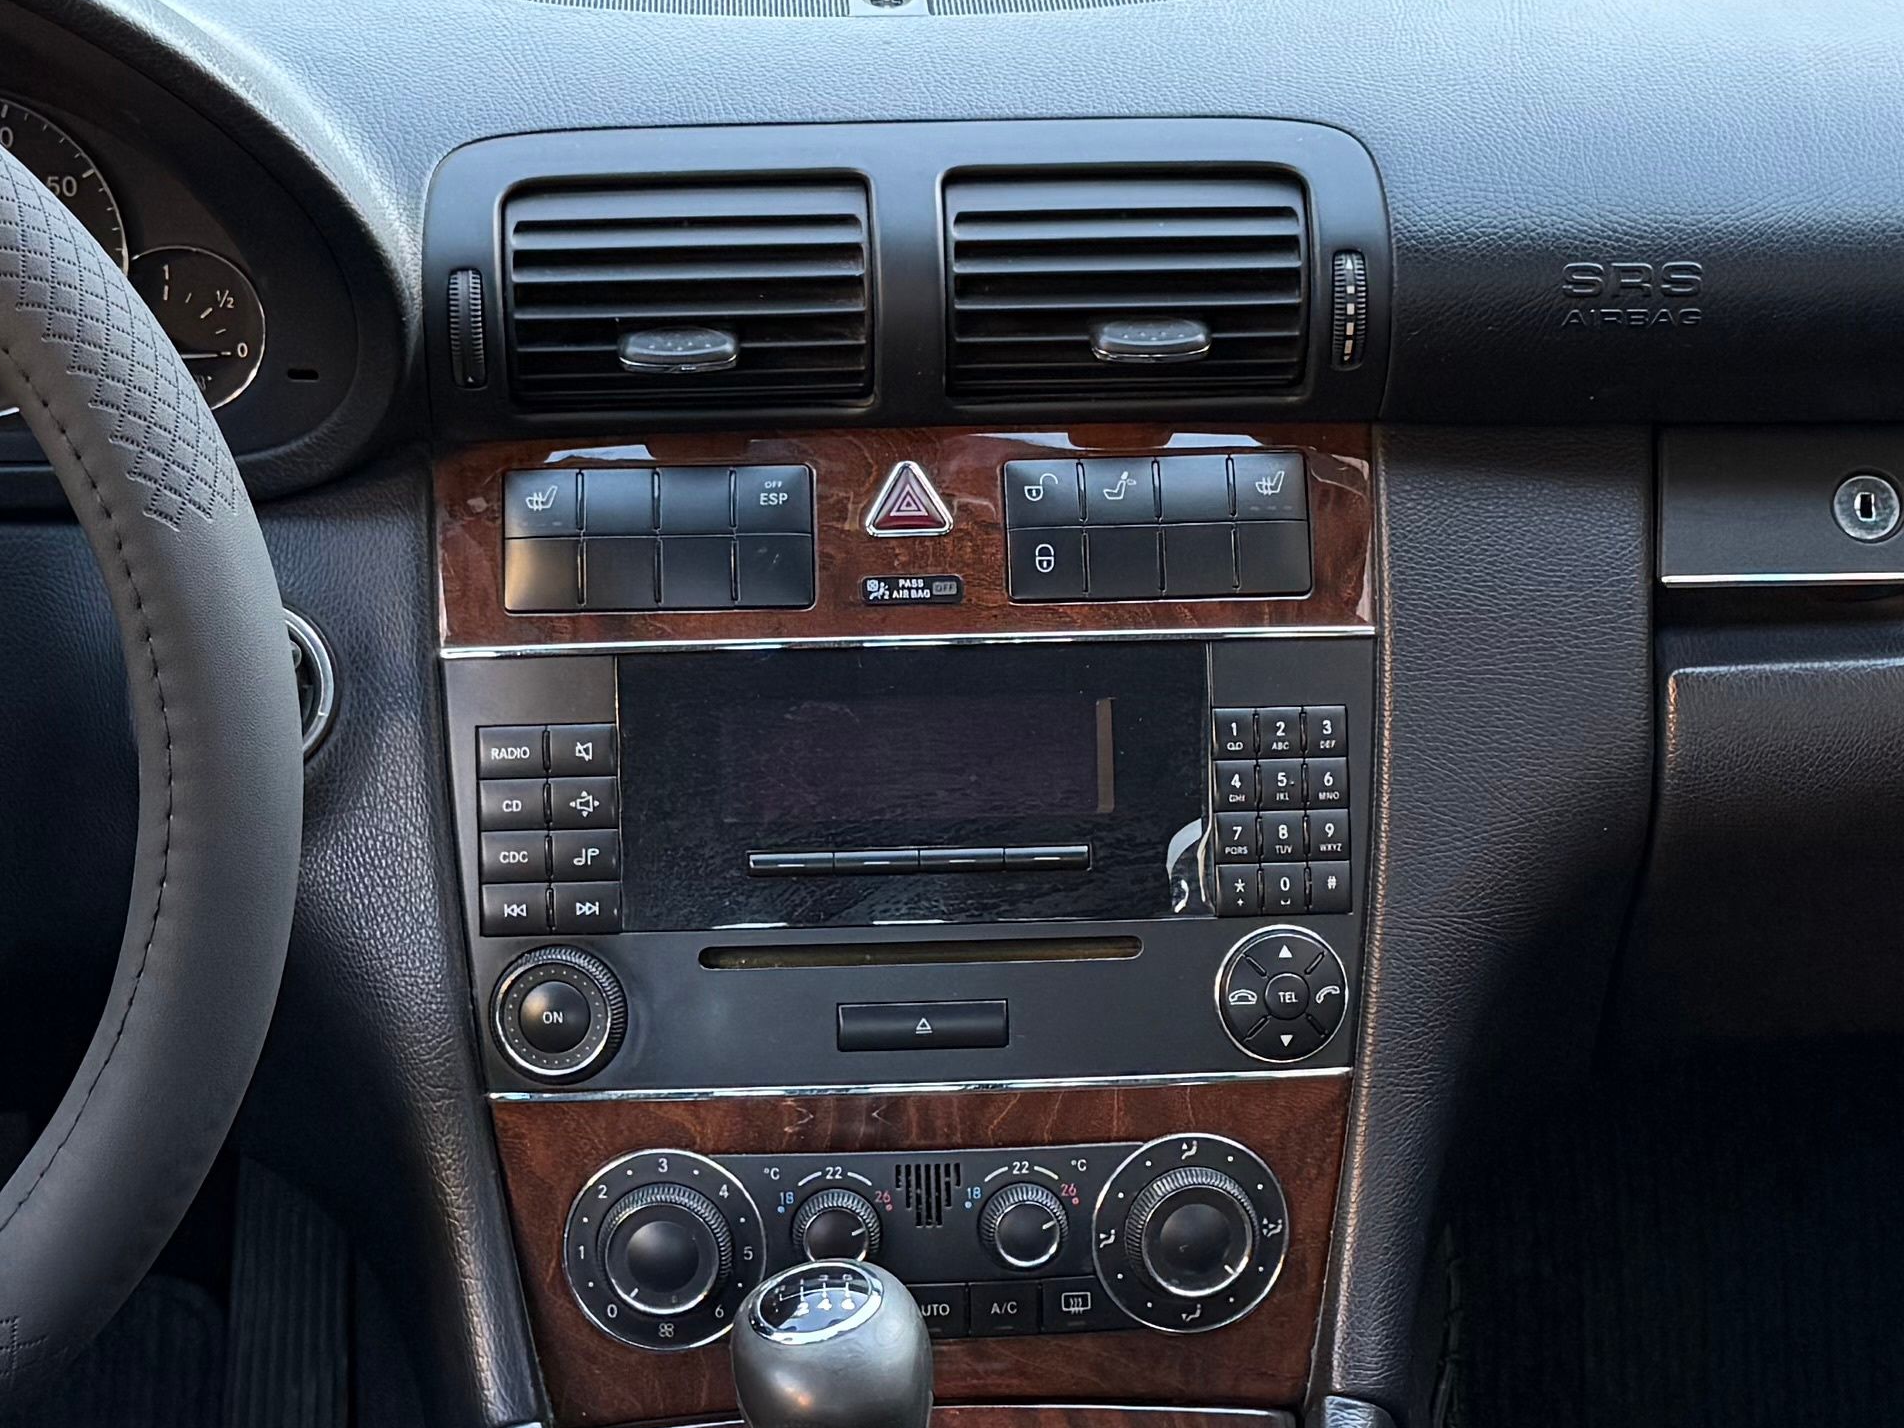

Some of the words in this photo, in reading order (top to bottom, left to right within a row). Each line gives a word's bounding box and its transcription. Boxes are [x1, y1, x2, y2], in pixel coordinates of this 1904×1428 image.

[46, 176, 77, 198] 50
[1562, 261, 1703, 298] SRS
[1560, 308, 1702, 328] AIRBAG
[237, 342, 248, 358] 0
[759, 491, 788, 506] ESP
[898, 579, 924, 588] PASS
[1230, 722, 1238, 737] 1
[1276, 721, 1286, 737] 2
[1322, 719, 1332, 735] 3
[1271, 741, 1290, 750] ABC
[491, 746, 530, 760] RADIO
[1230, 773, 1242, 789] 4
[1277, 772, 1287, 787] 5
[1323, 771, 1334, 787] 6
[1318, 791, 1340, 800] MNO
[502, 799, 522, 812] CD
[1232, 826, 1243, 840] 7
[1278, 824, 1288, 840] 8
[1324, 822, 1335, 838] 9
[1275, 844, 1293, 854] TUV
[499, 851, 529, 864] CDC
[1280, 876, 1290, 891] 0
[1278, 991, 1298, 1003] TEL
[542, 1011, 564, 1024] ON
[658, 1158, 668, 1172] 3
[1012, 1161, 1030, 1174] 22
[825, 1167, 843, 1180] 22
[598, 1185, 608, 1199] 2
[719, 1184, 729, 1199] 4
[874, 1190, 891, 1204] 26
[966, 1187, 981, 1200] 18
[1060, 1183, 1077, 1197] 26
[779, 1191, 794, 1205] 18
[578, 1245, 585, 1260] 1
[743, 1246, 753, 1261] 5
[607, 1304, 618, 1318] 0
[715, 1304, 725, 1318] 6
[921, 1303, 950, 1317] UTO
[991, 1301, 1017, 1315] A/C
